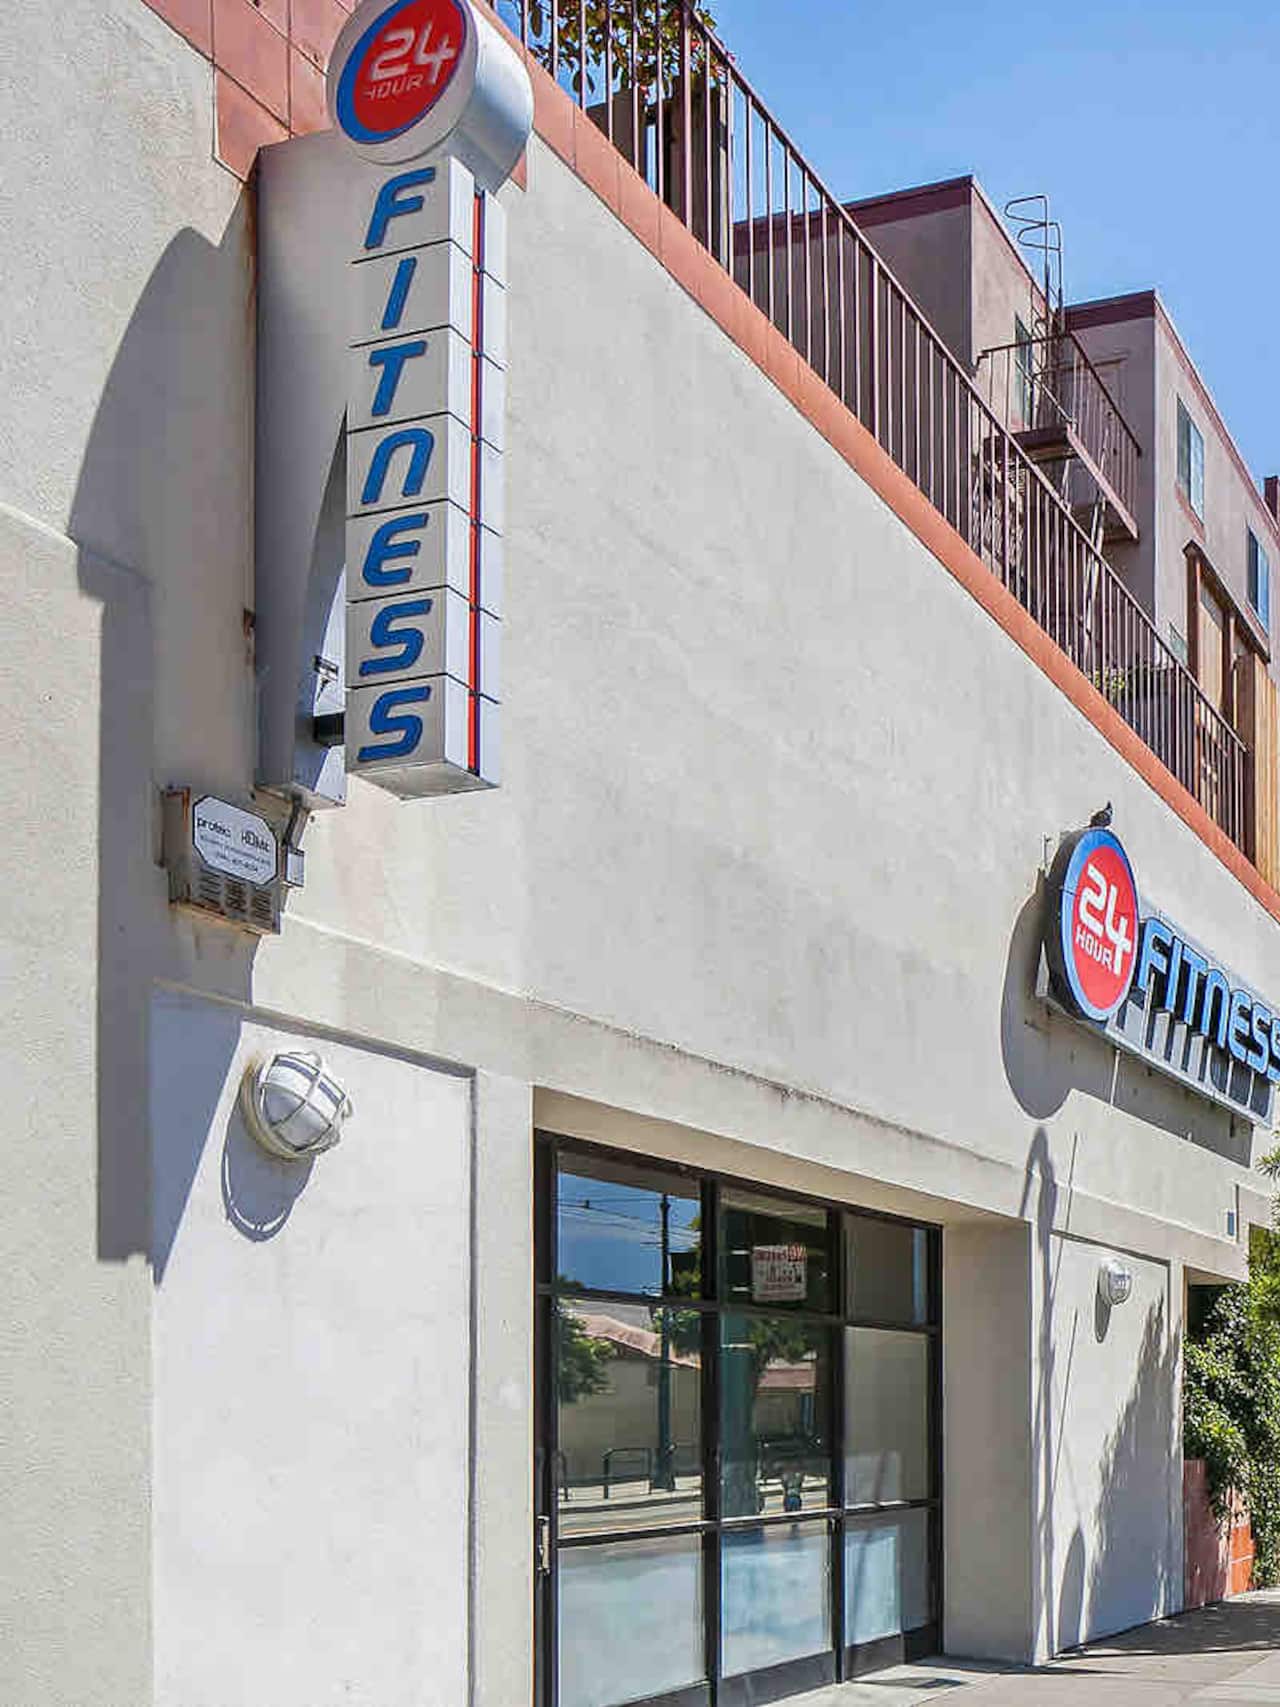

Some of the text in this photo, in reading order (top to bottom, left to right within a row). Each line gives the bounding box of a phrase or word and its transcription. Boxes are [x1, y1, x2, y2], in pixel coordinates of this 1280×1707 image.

[370, 21, 456, 85] 24
[362, 74, 424, 100] HOUR
[357, 166, 437, 763] FITNESS
[1075, 926, 1114, 973] HOUR
[1078, 863, 1132, 977] 24
